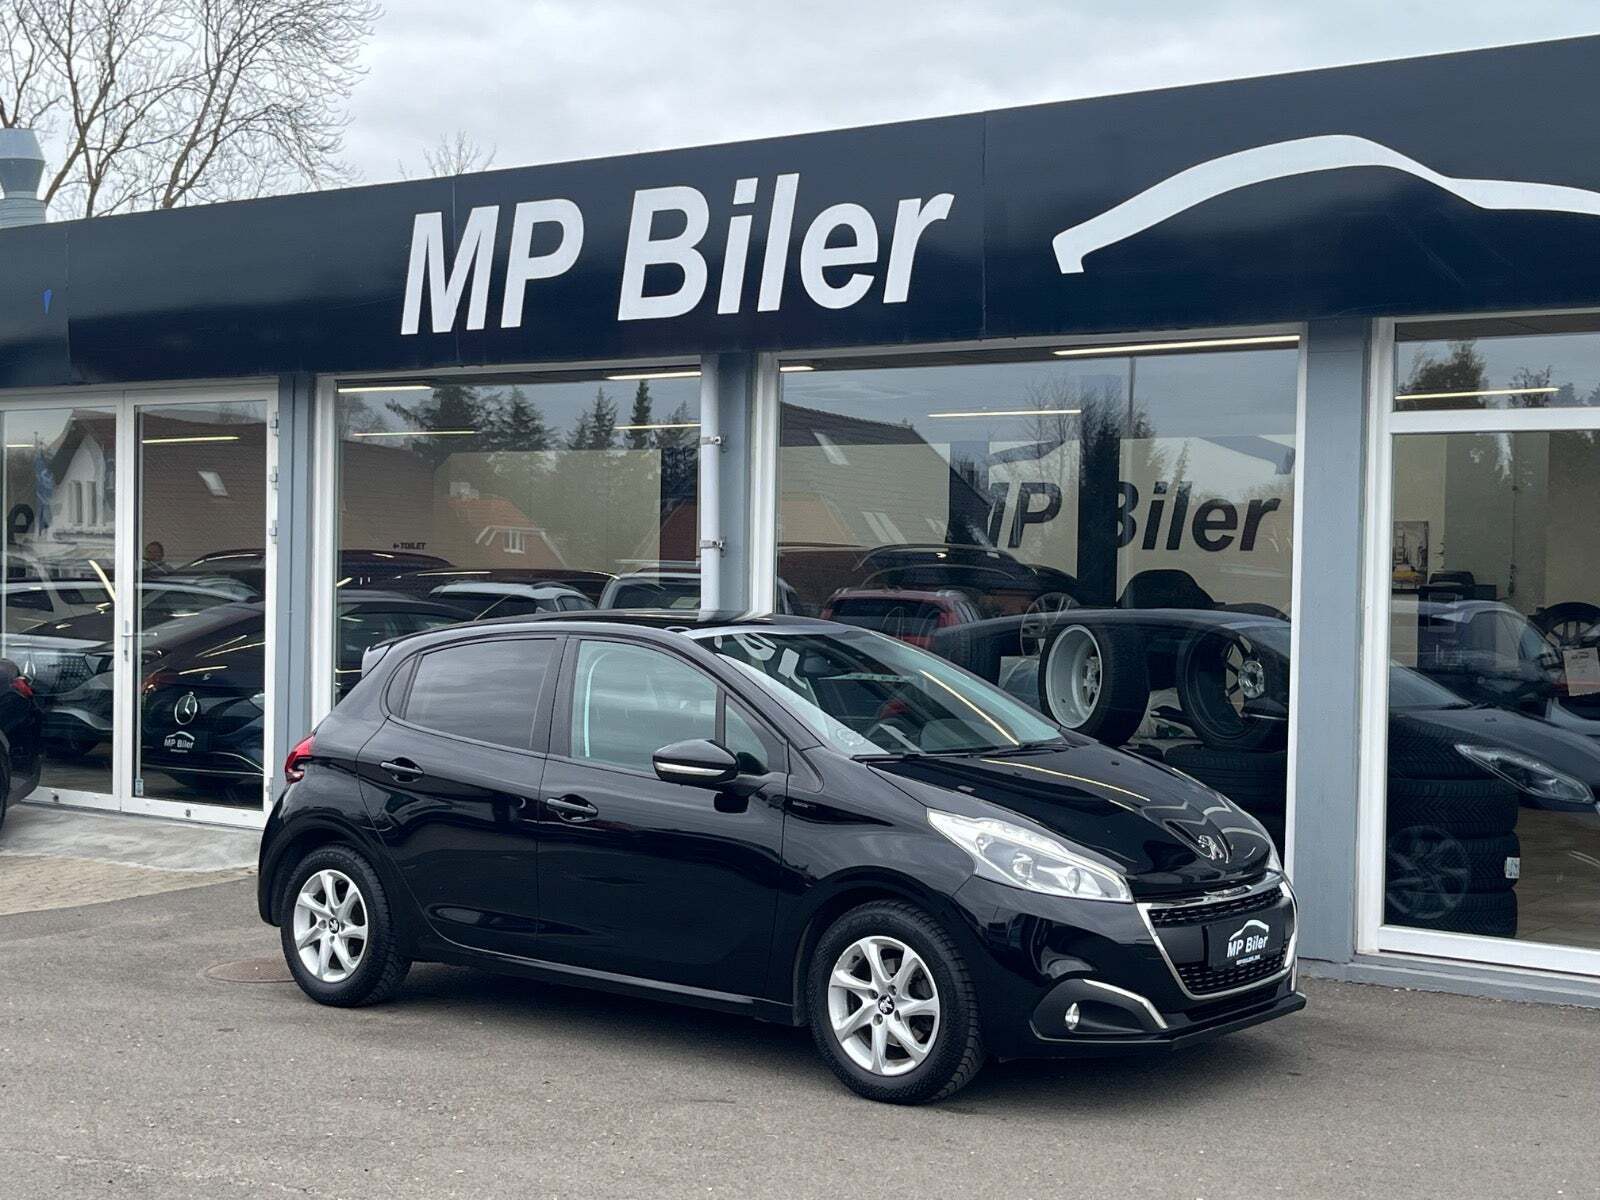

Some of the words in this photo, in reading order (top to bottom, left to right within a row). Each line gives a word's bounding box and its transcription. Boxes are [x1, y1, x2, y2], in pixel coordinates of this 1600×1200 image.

[400, 197, 585, 336] MP
[617, 172, 955, 322] Biler
[164, 738, 176, 747] MP
[1226, 939, 1244, 958] MP
[1245, 935, 1269, 953] Biler
